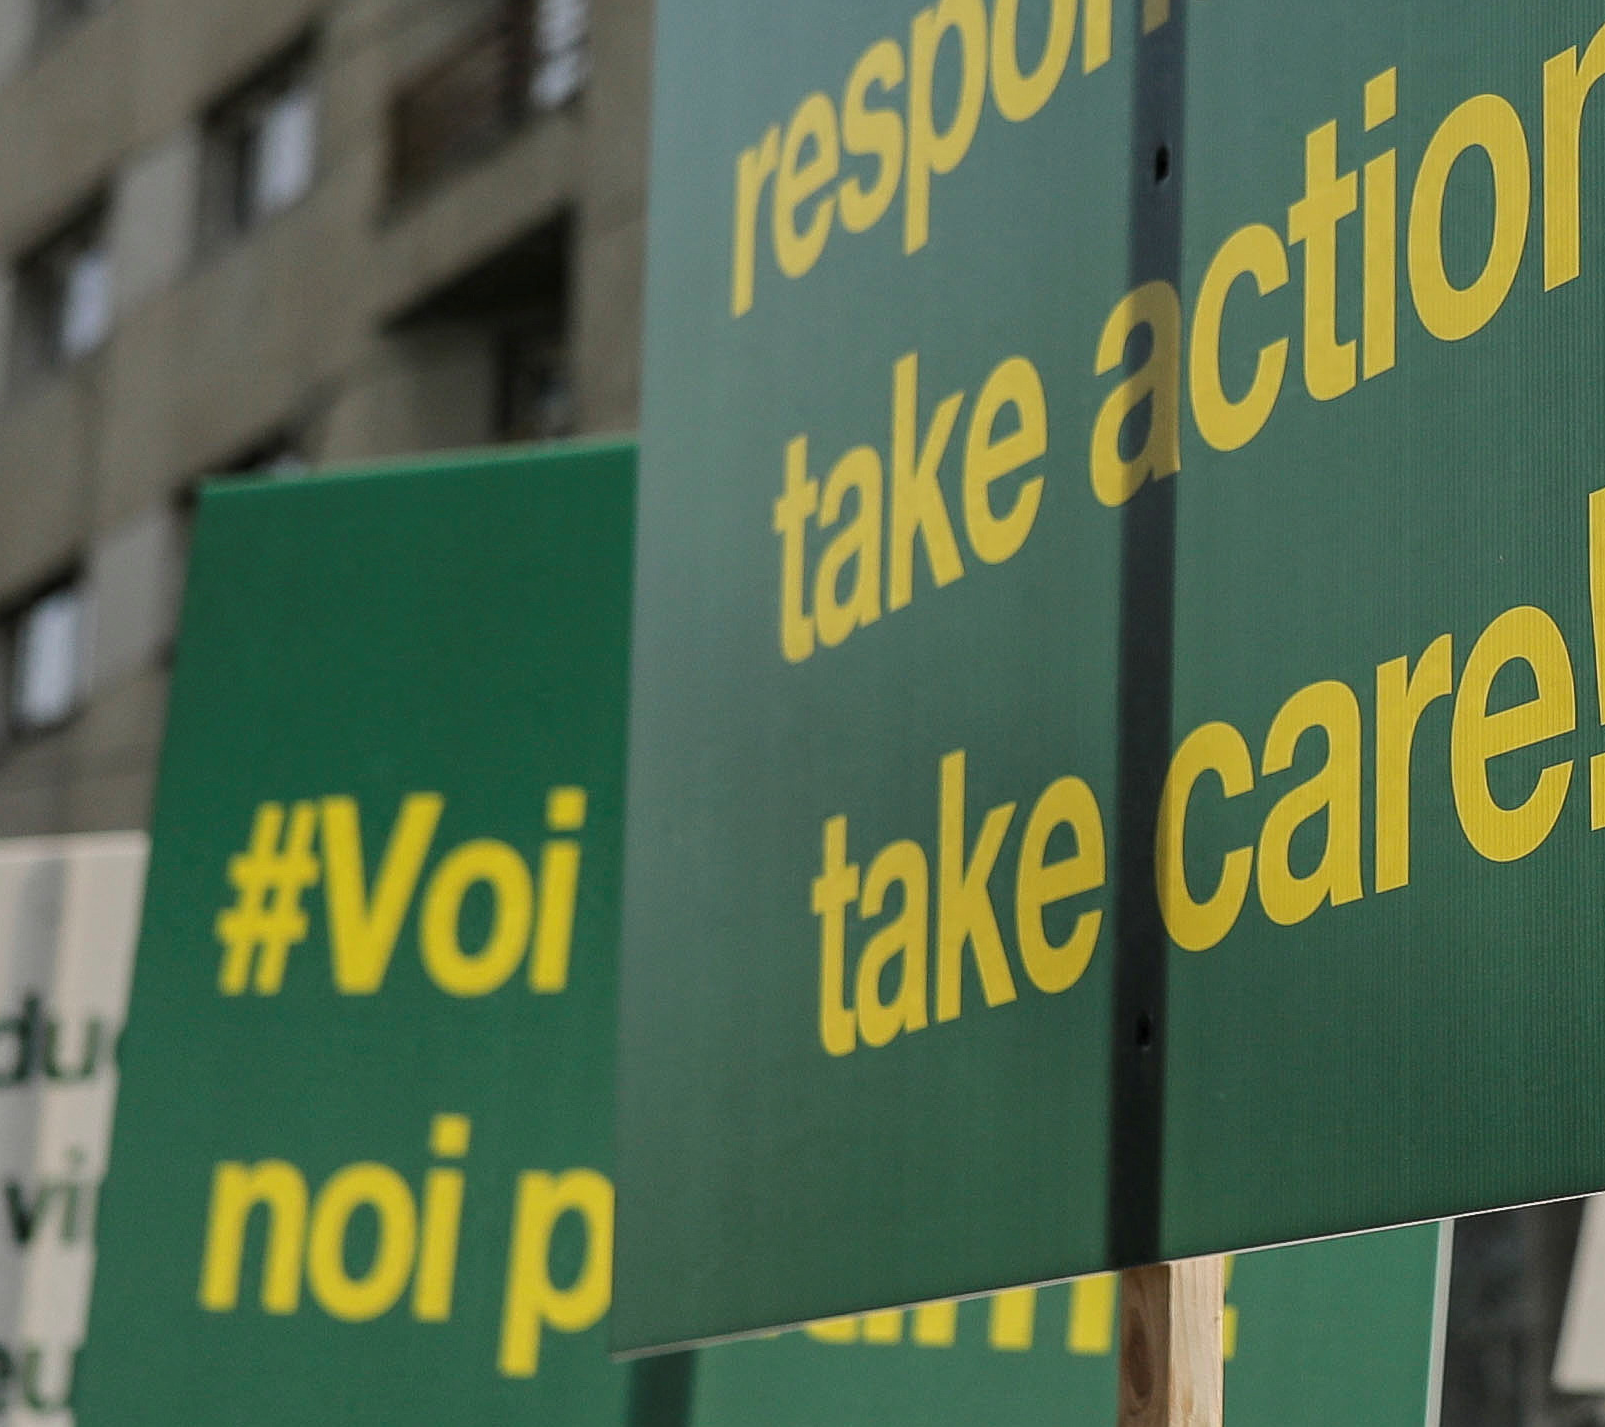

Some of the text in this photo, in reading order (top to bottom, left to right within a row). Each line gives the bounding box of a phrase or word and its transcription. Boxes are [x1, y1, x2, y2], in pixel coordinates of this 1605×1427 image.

[773, 352, 1049, 664] take
[215, 786, 588, 997] #Voi
[810, 749, 1107, 1059] take
[200, 1113, 472, 1323] noi
